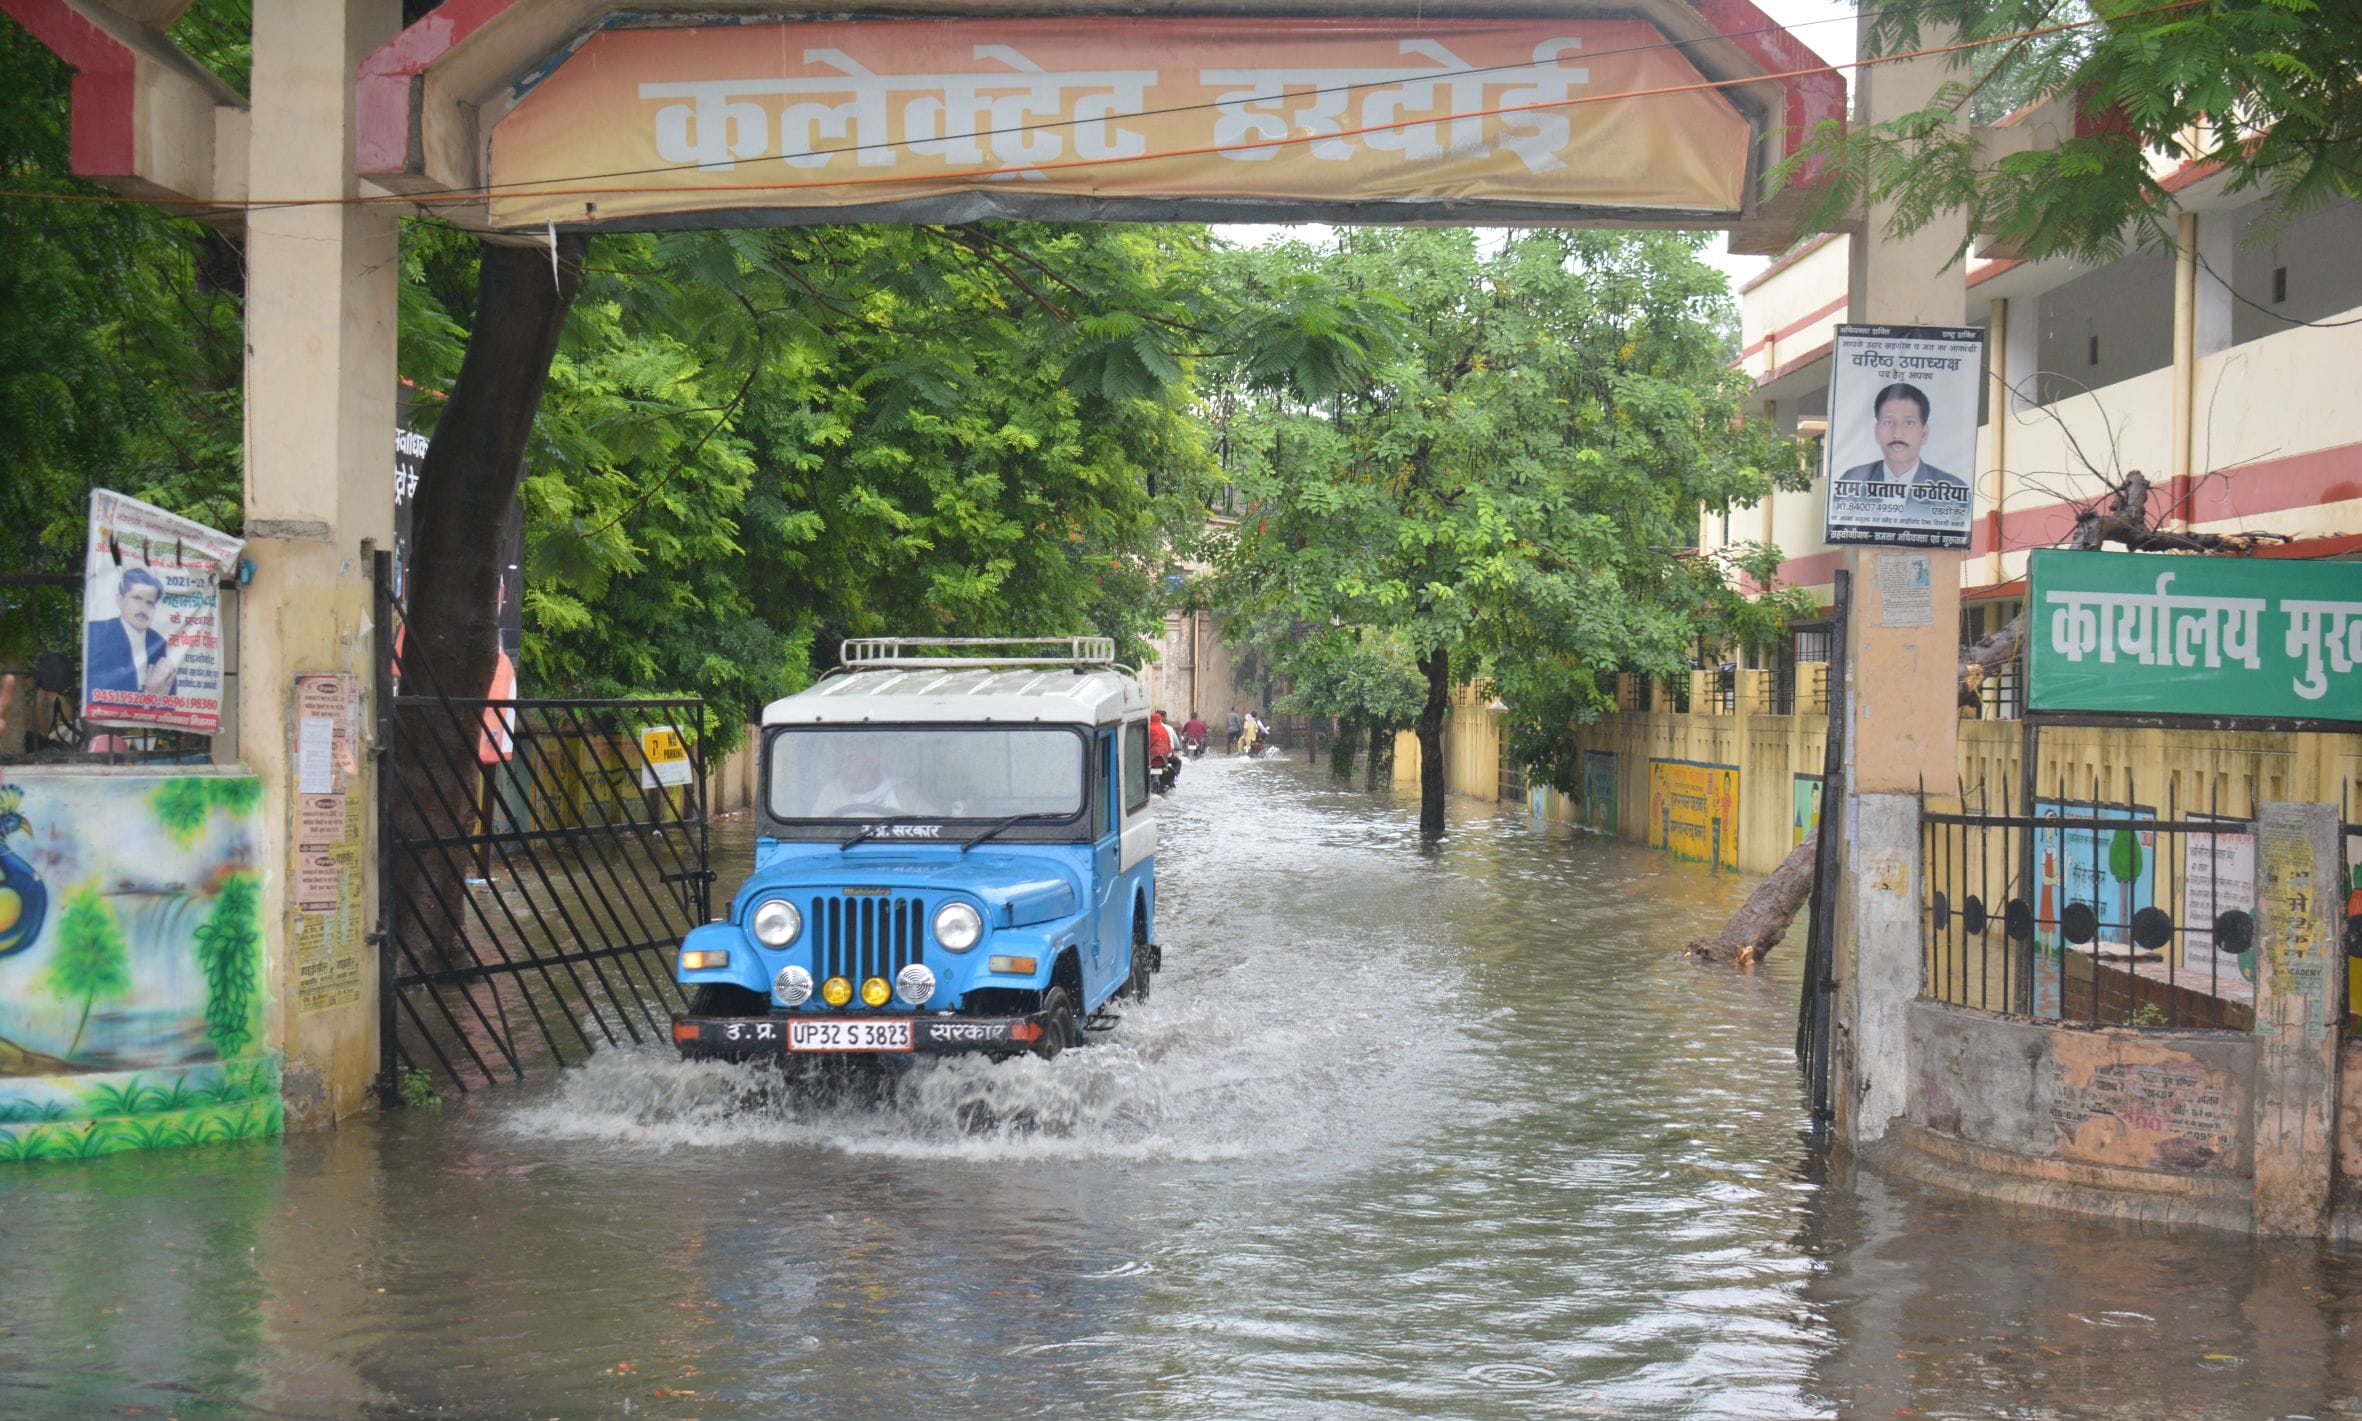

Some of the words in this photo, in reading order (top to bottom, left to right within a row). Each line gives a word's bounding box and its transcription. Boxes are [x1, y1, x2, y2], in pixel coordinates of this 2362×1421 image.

[1200, 37, 1588, 174] हरदोई
[1852, 350, 1894, 368] वरिष्ठ
[1899, 356, 1962, 371] उपाध्यक्ष
[1834, 481, 1861, 496] राम
[1866, 482, 1907, 499] प्रताप
[1912, 481, 1969, 501] कठेरिया
[2046, 572, 2266, 670] कार्यालय
[668, 732, 677, 747] NO
[892, 825, 943, 838] सरकार
[794, 1025, 840, 1046] UP32
[847, 1026, 859, 1045] S
[866, 1025, 909, 1046] 3823
[930, 1023, 1005, 1042] सरकार
